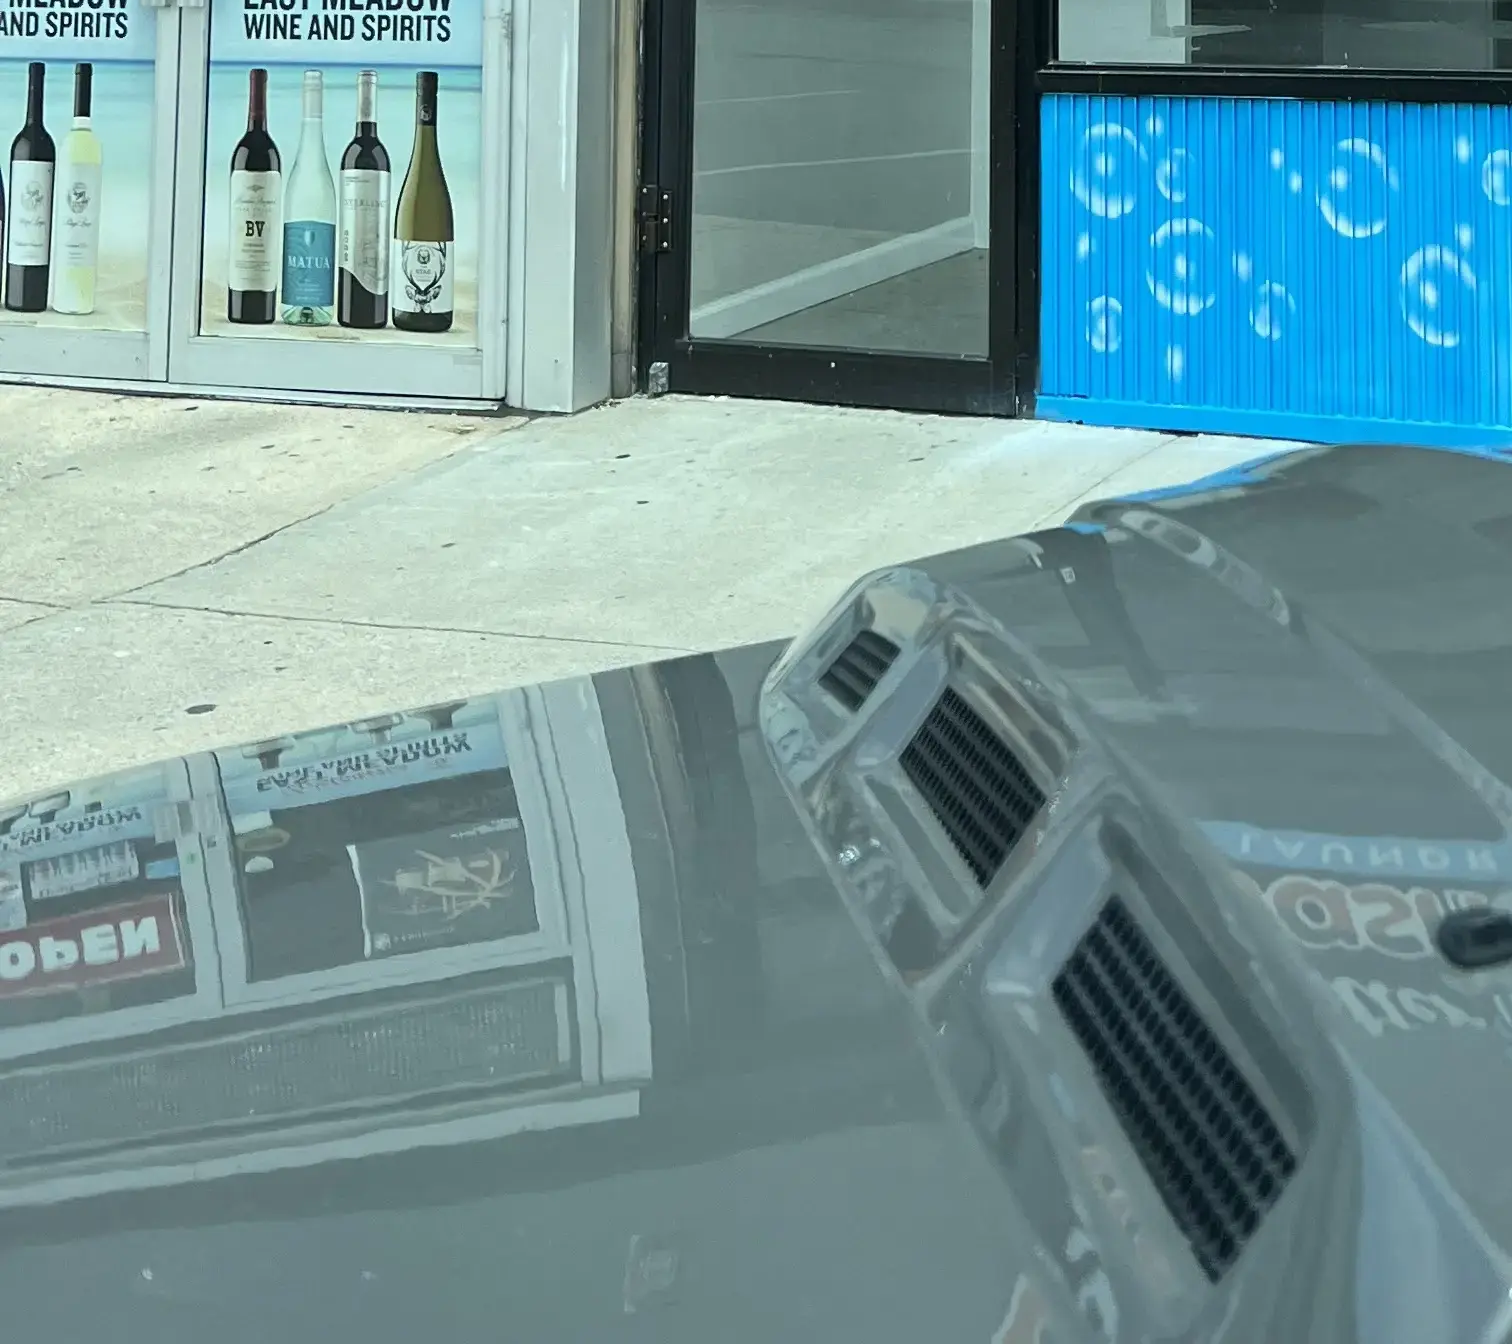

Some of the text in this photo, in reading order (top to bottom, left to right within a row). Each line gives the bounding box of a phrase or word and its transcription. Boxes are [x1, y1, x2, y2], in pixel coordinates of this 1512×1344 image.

[0, 11, 128, 38] AND SPIRITS
[244, 13, 451, 42] WINE AND SPIRITS
[245, 220, 266, 237] BV
[287, 255, 330, 269] MATUA
